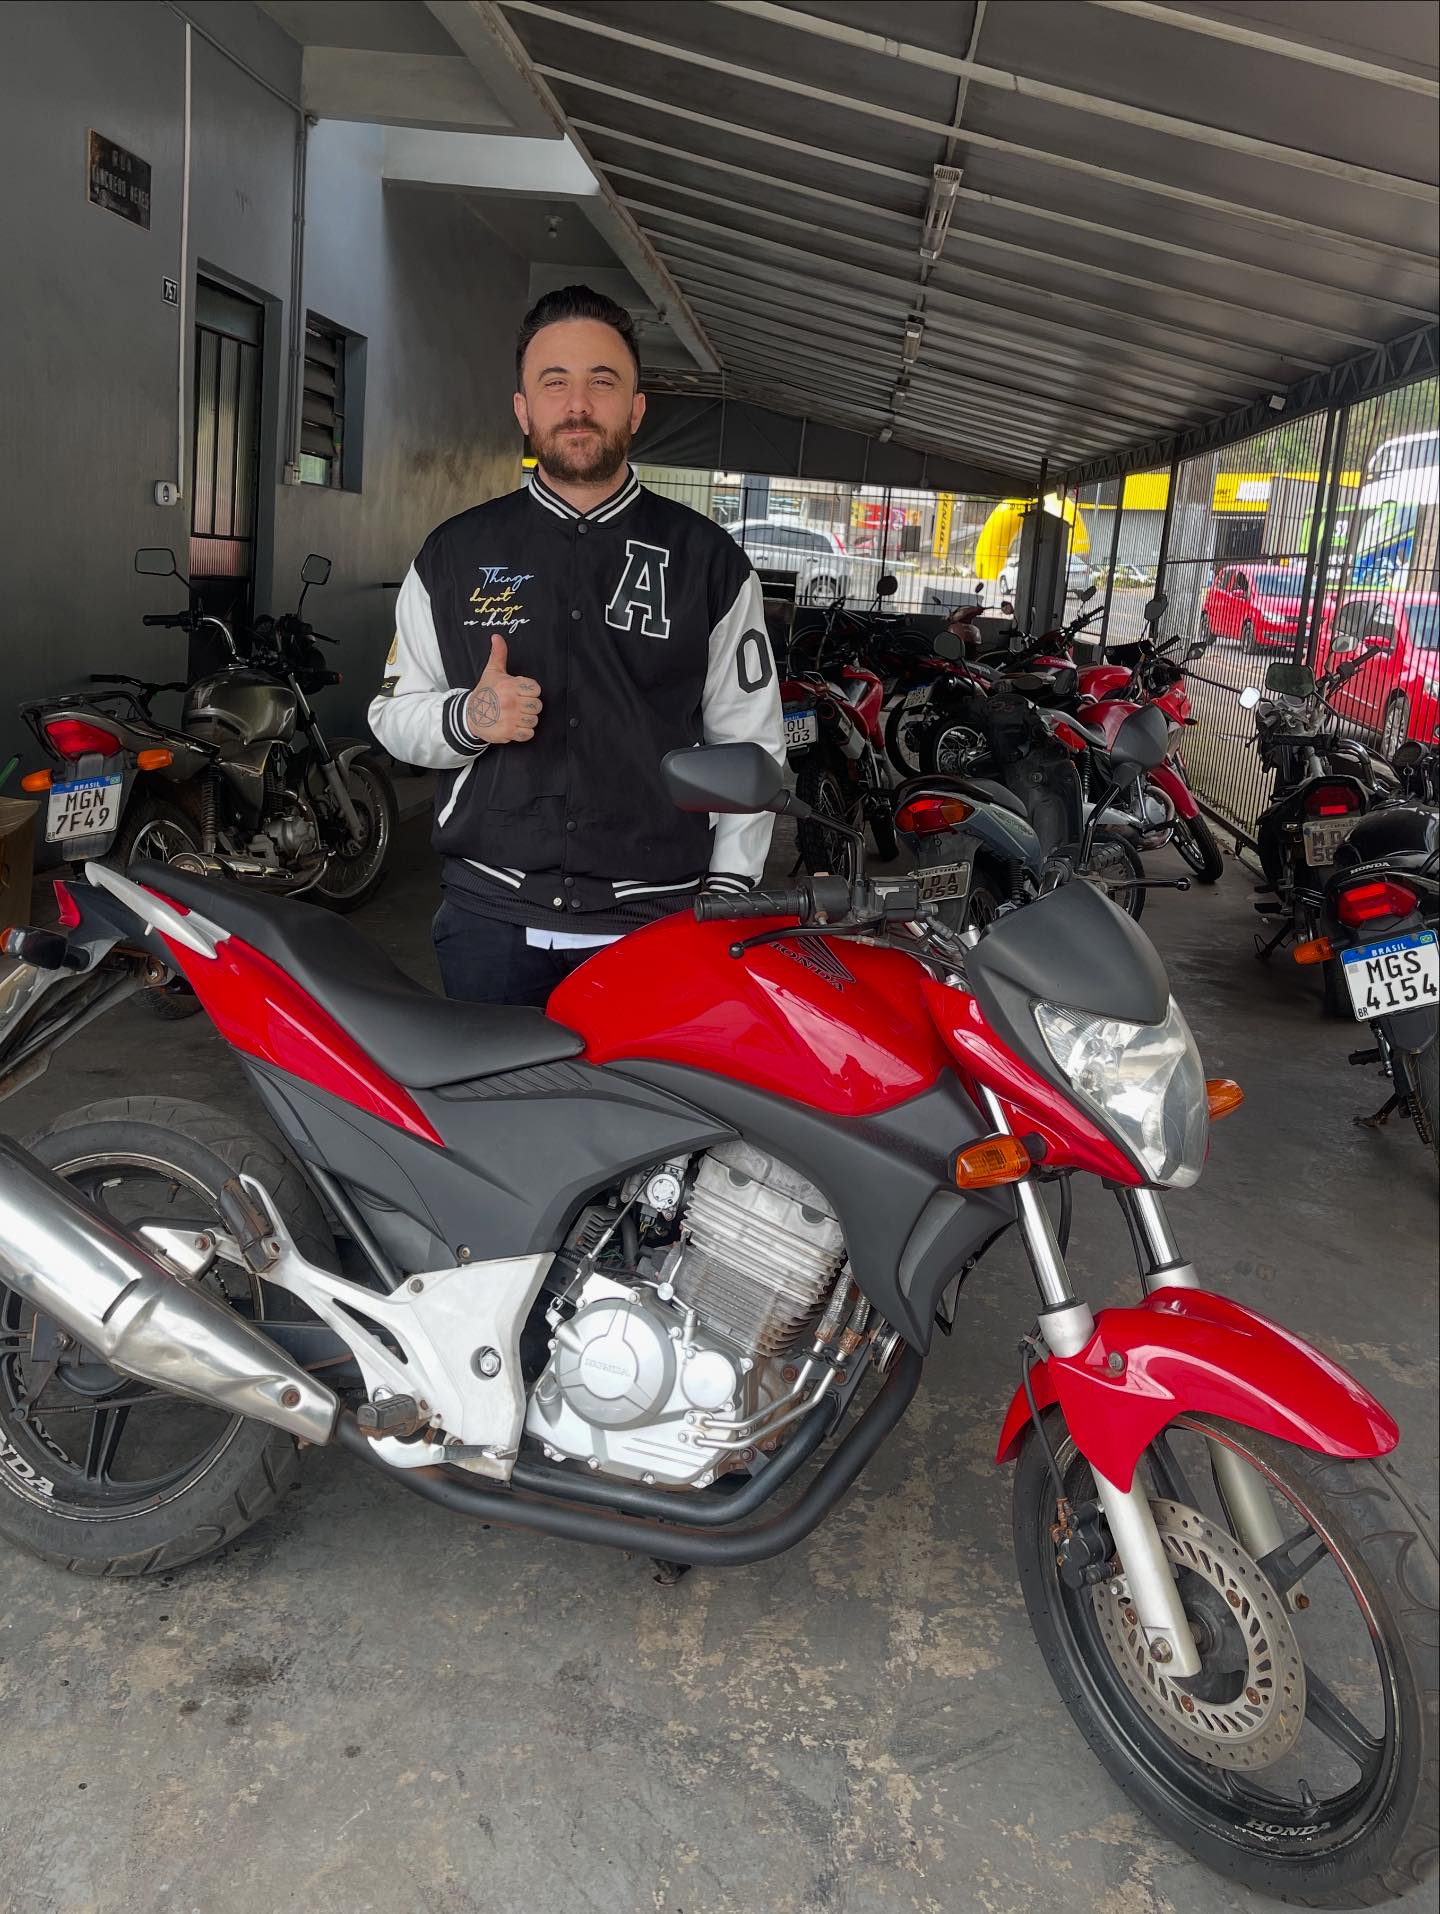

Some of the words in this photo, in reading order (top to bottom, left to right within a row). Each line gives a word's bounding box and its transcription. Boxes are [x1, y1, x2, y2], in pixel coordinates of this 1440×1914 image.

[112, 149, 132, 173] RUA
[165, 280, 177, 301] 757
[469, 587, 487, 602] do
[488, 586, 516, 602] not
[605, 539, 671, 640] A
[474, 599, 524, 621] change
[481, 612, 531, 634] change
[73, 781, 101, 792] BRASIL
[65, 788, 106, 813] MGN
[55, 807, 110, 835] 7F49
[1350, 861, 1391, 875] HONDA
[1371, 942, 1407, 957] BRASIL
[768, 941, 845, 993] HONDA
[1365, 950, 1422, 984] MGS
[1366, 973, 1438, 1010] 4I54
[1357, 1007, 1369, 1018] BR
[1245, 1819, 1331, 1836] HONDA
